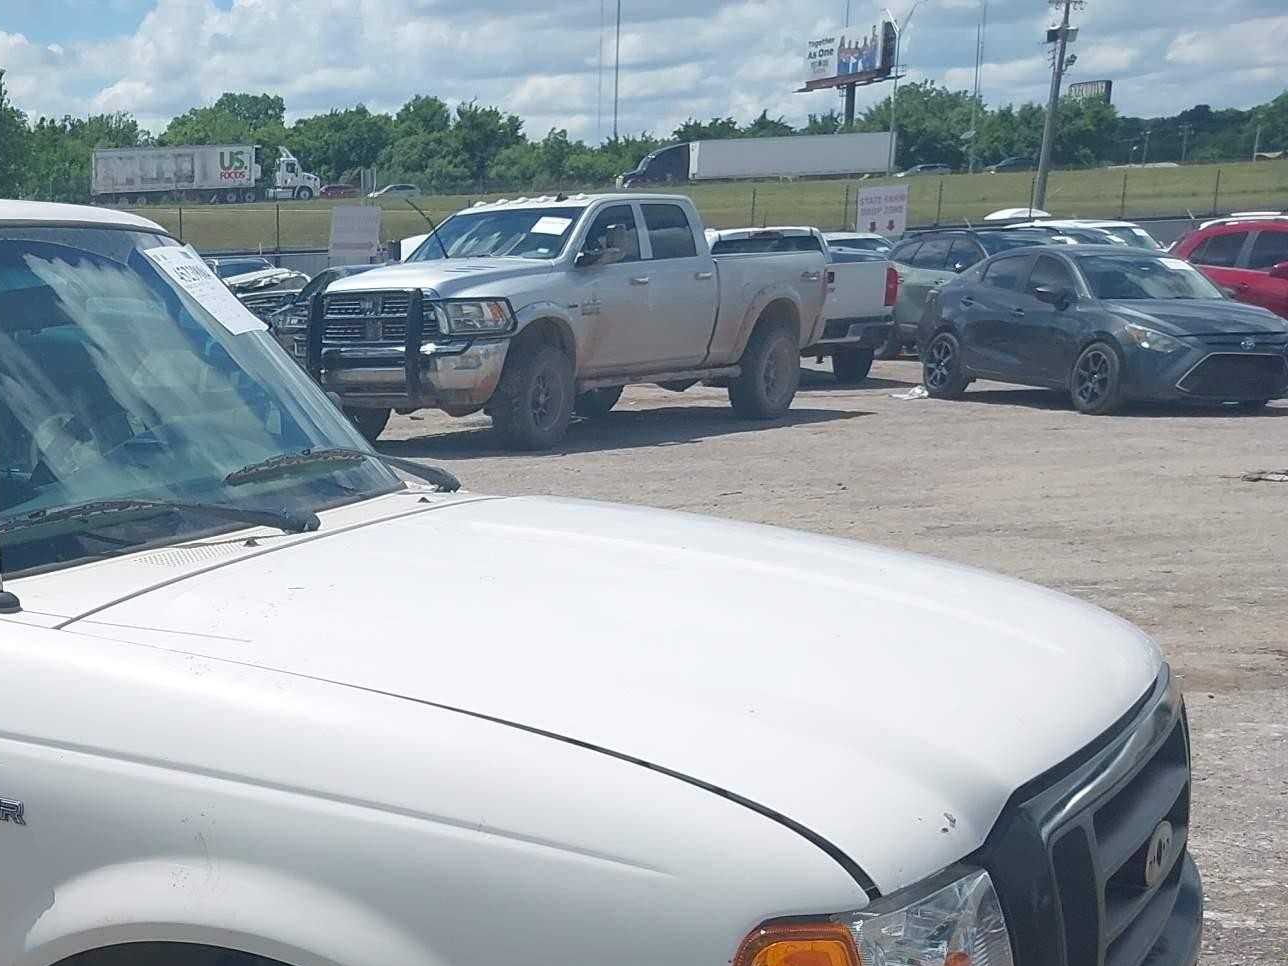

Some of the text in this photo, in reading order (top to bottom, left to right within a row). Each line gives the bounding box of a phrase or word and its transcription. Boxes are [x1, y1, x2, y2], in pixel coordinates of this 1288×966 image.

[808, 48, 834, 59] As One
[860, 193, 906, 206] STATE FARM
[860, 205, 905, 217] DROP ZONE
